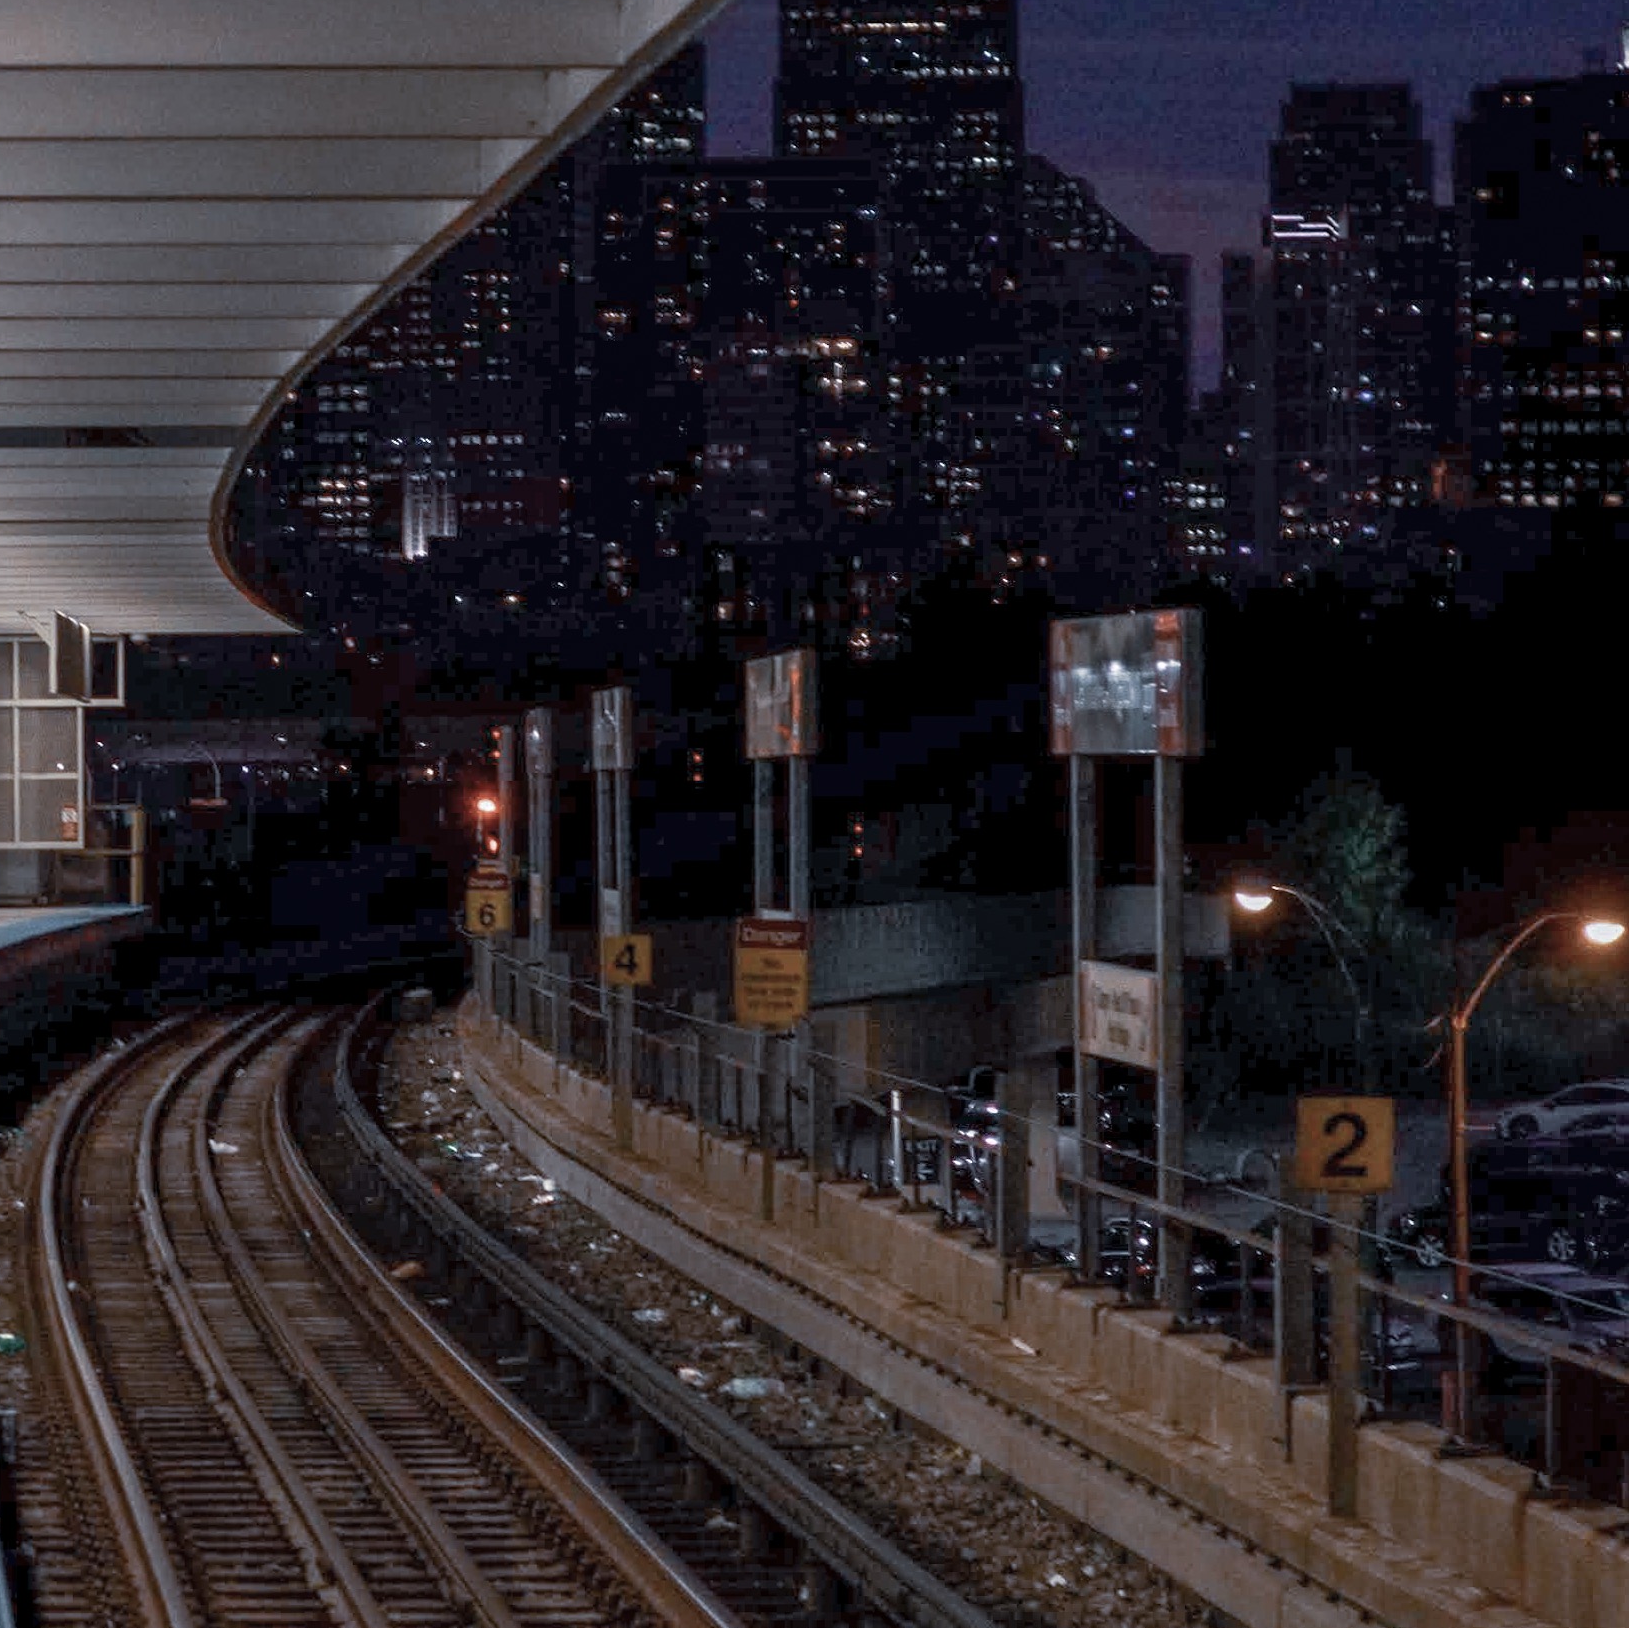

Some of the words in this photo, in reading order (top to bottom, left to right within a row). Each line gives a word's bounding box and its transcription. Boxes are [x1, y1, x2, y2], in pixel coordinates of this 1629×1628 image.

[479, 903, 496, 927] 6
[615, 943, 638, 977] 4
[1322, 1112, 1369, 1179] 2
